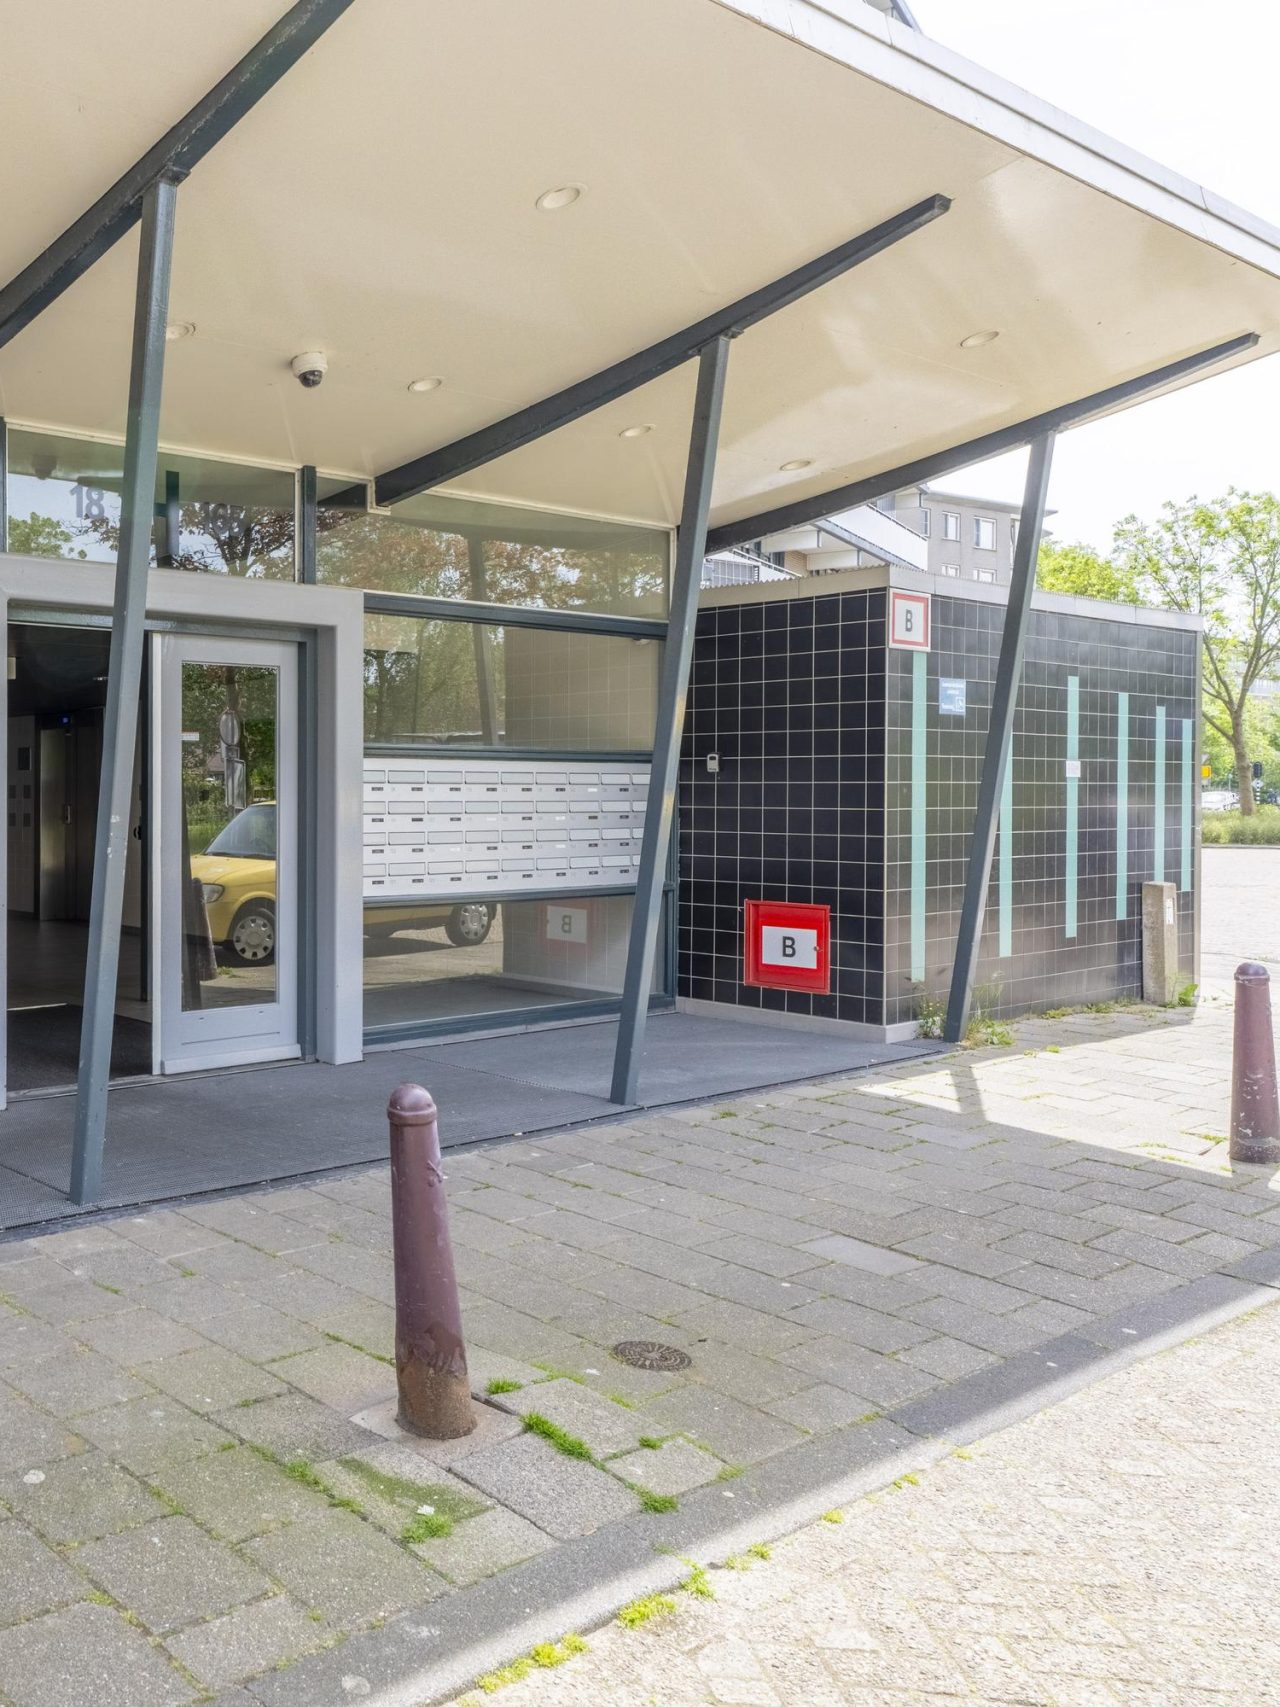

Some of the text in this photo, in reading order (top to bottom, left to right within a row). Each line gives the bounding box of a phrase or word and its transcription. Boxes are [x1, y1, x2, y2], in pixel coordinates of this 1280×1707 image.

[70, 485, 105, 520] 18
[905, 608, 913, 633] B
[782, 936, 796, 958] B
